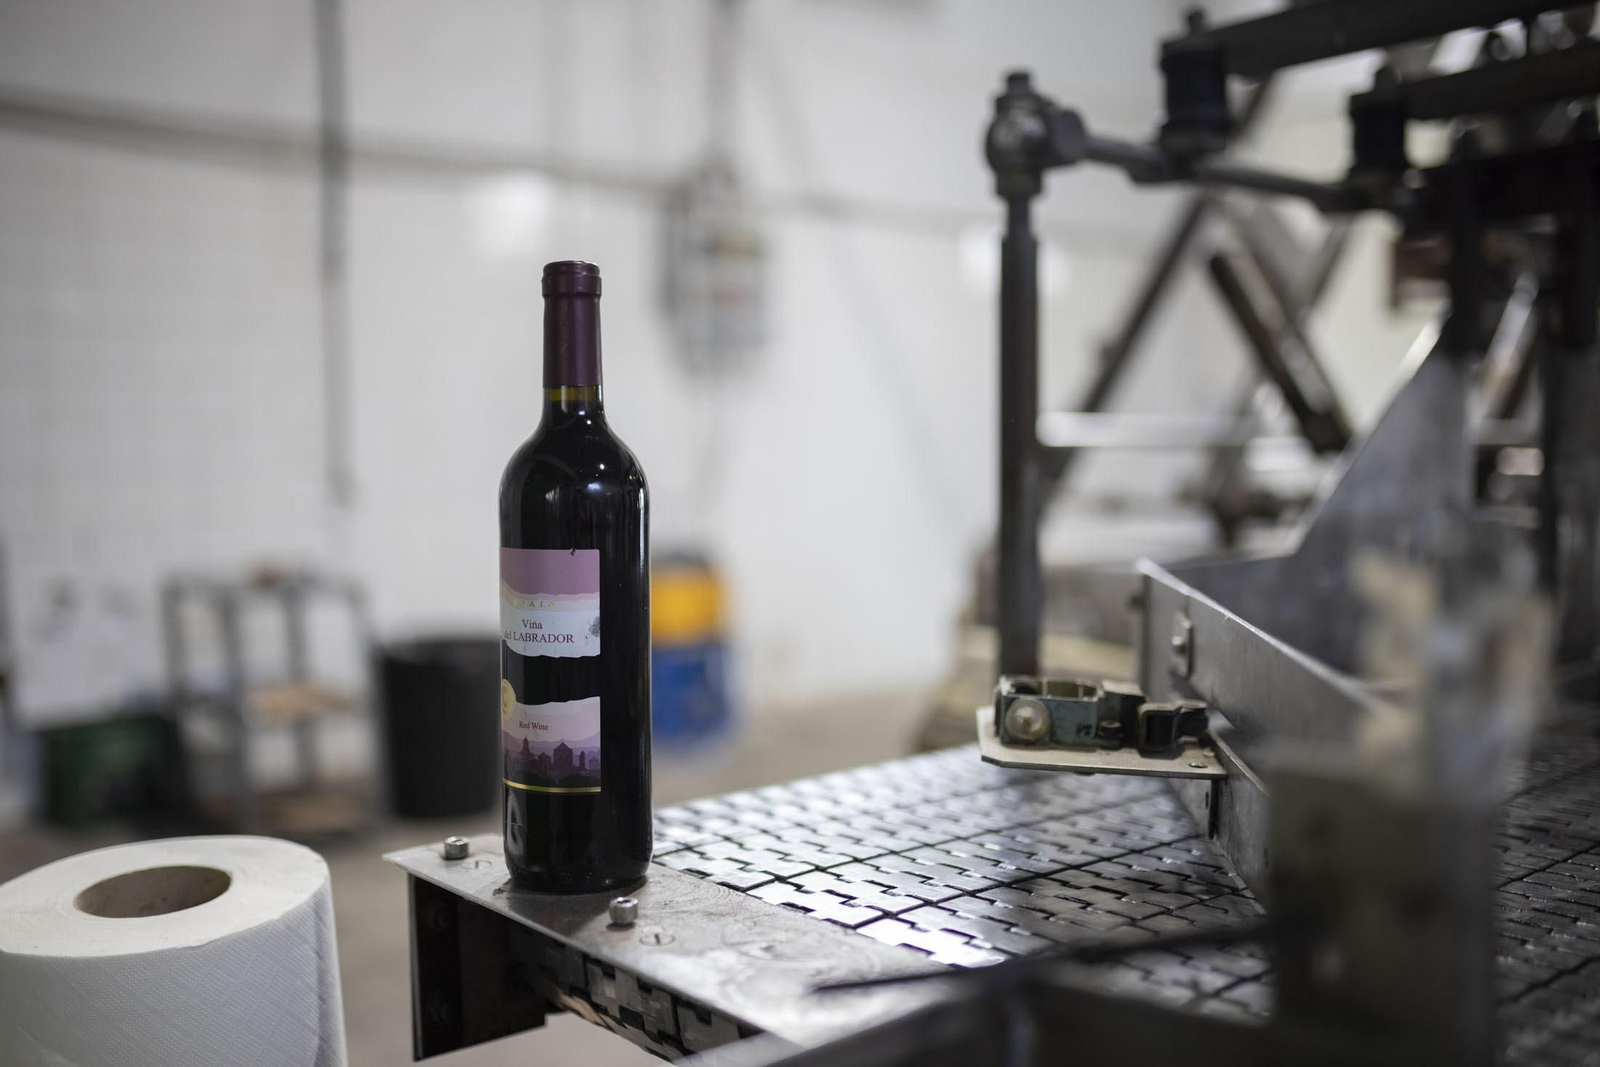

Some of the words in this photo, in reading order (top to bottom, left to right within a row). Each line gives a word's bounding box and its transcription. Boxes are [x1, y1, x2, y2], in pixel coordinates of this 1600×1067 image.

[522, 619, 543, 630] Viña
[504, 629, 512, 640] del
[513, 631, 574, 643] LABRADOR
[519, 721, 531, 729] Red
[531, 722, 549, 731] Wine
